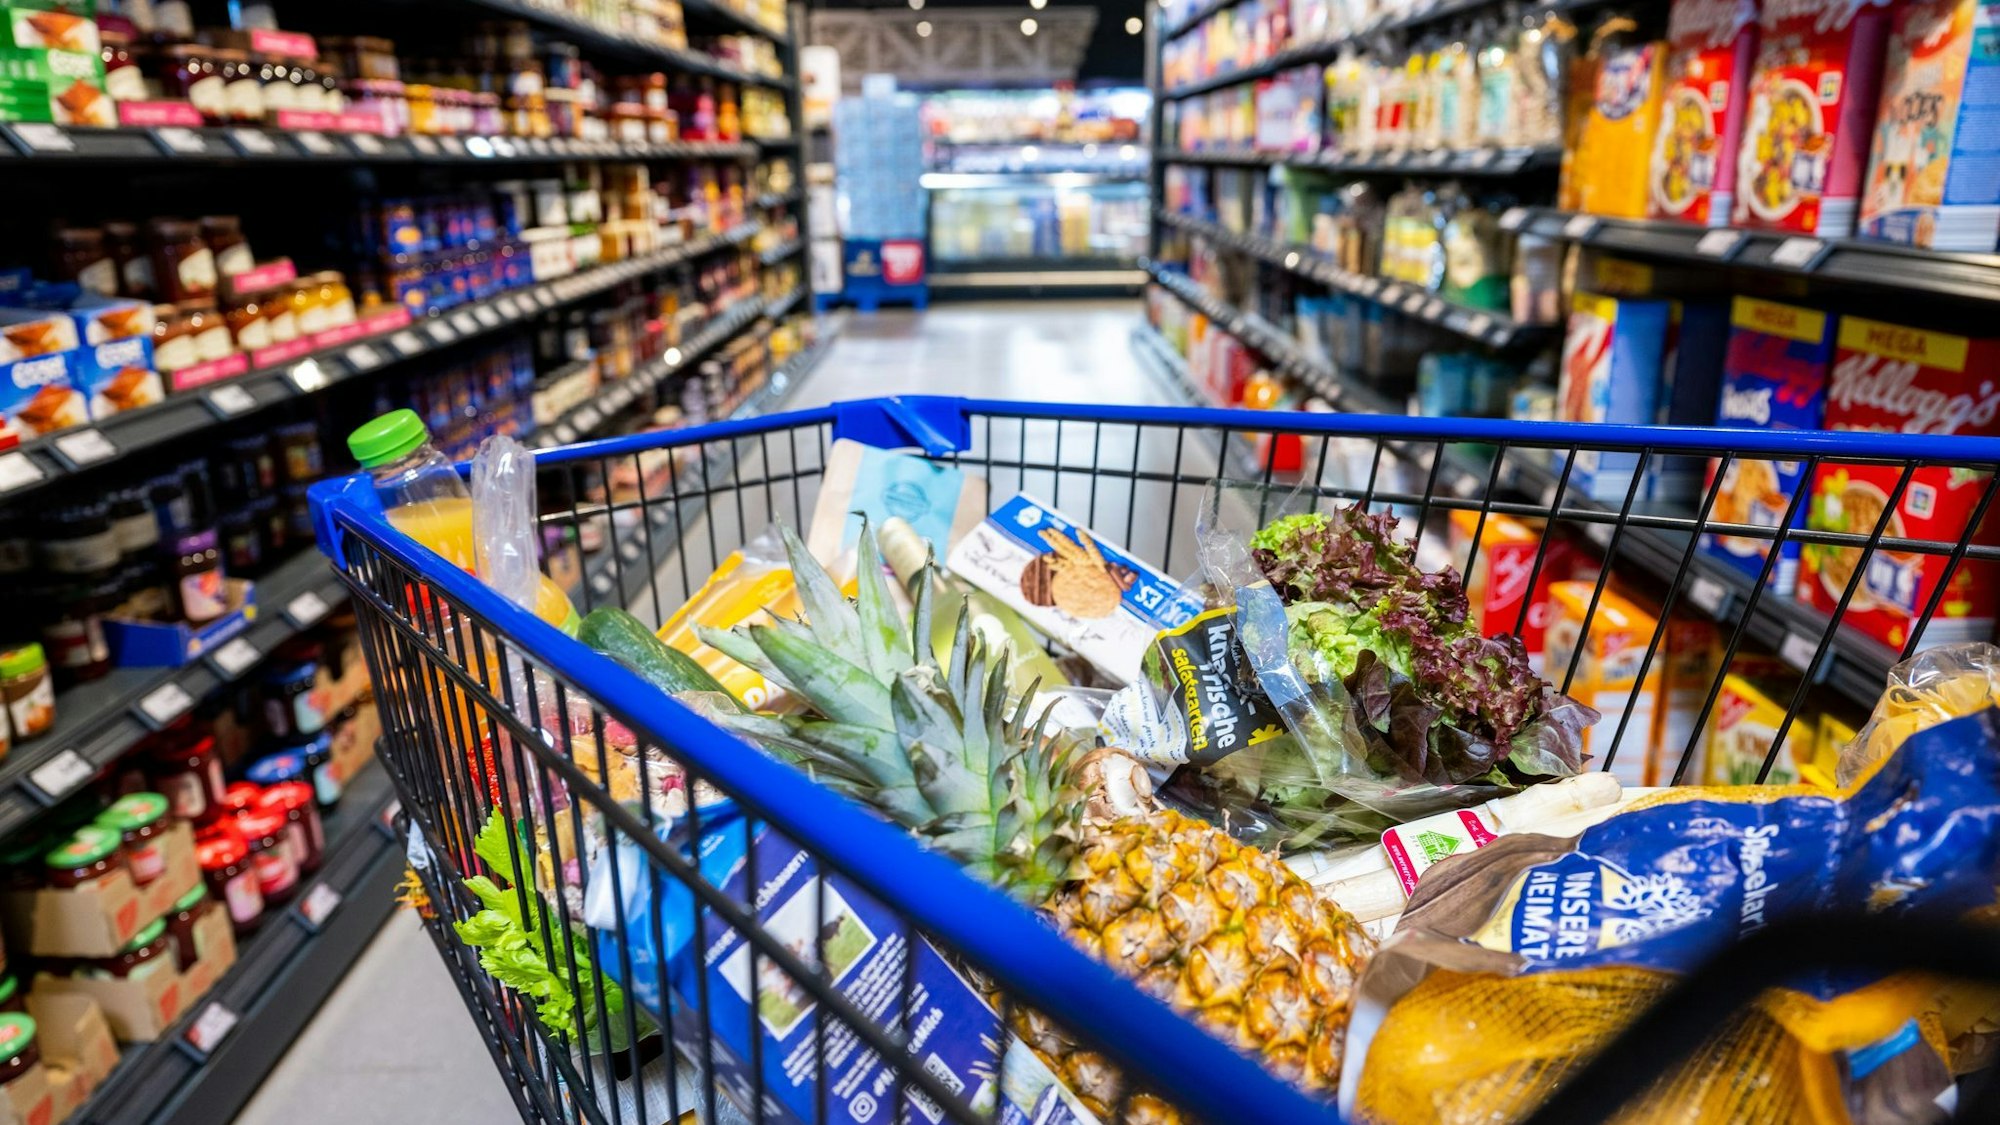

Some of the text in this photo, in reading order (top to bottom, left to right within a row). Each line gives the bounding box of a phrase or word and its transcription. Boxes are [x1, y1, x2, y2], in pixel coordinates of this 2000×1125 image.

[1866, 328, 1927, 355] MEGA
[1829, 352, 2000, 434] Kellogg's
[1519, 870, 1561, 961] HEIMAT
